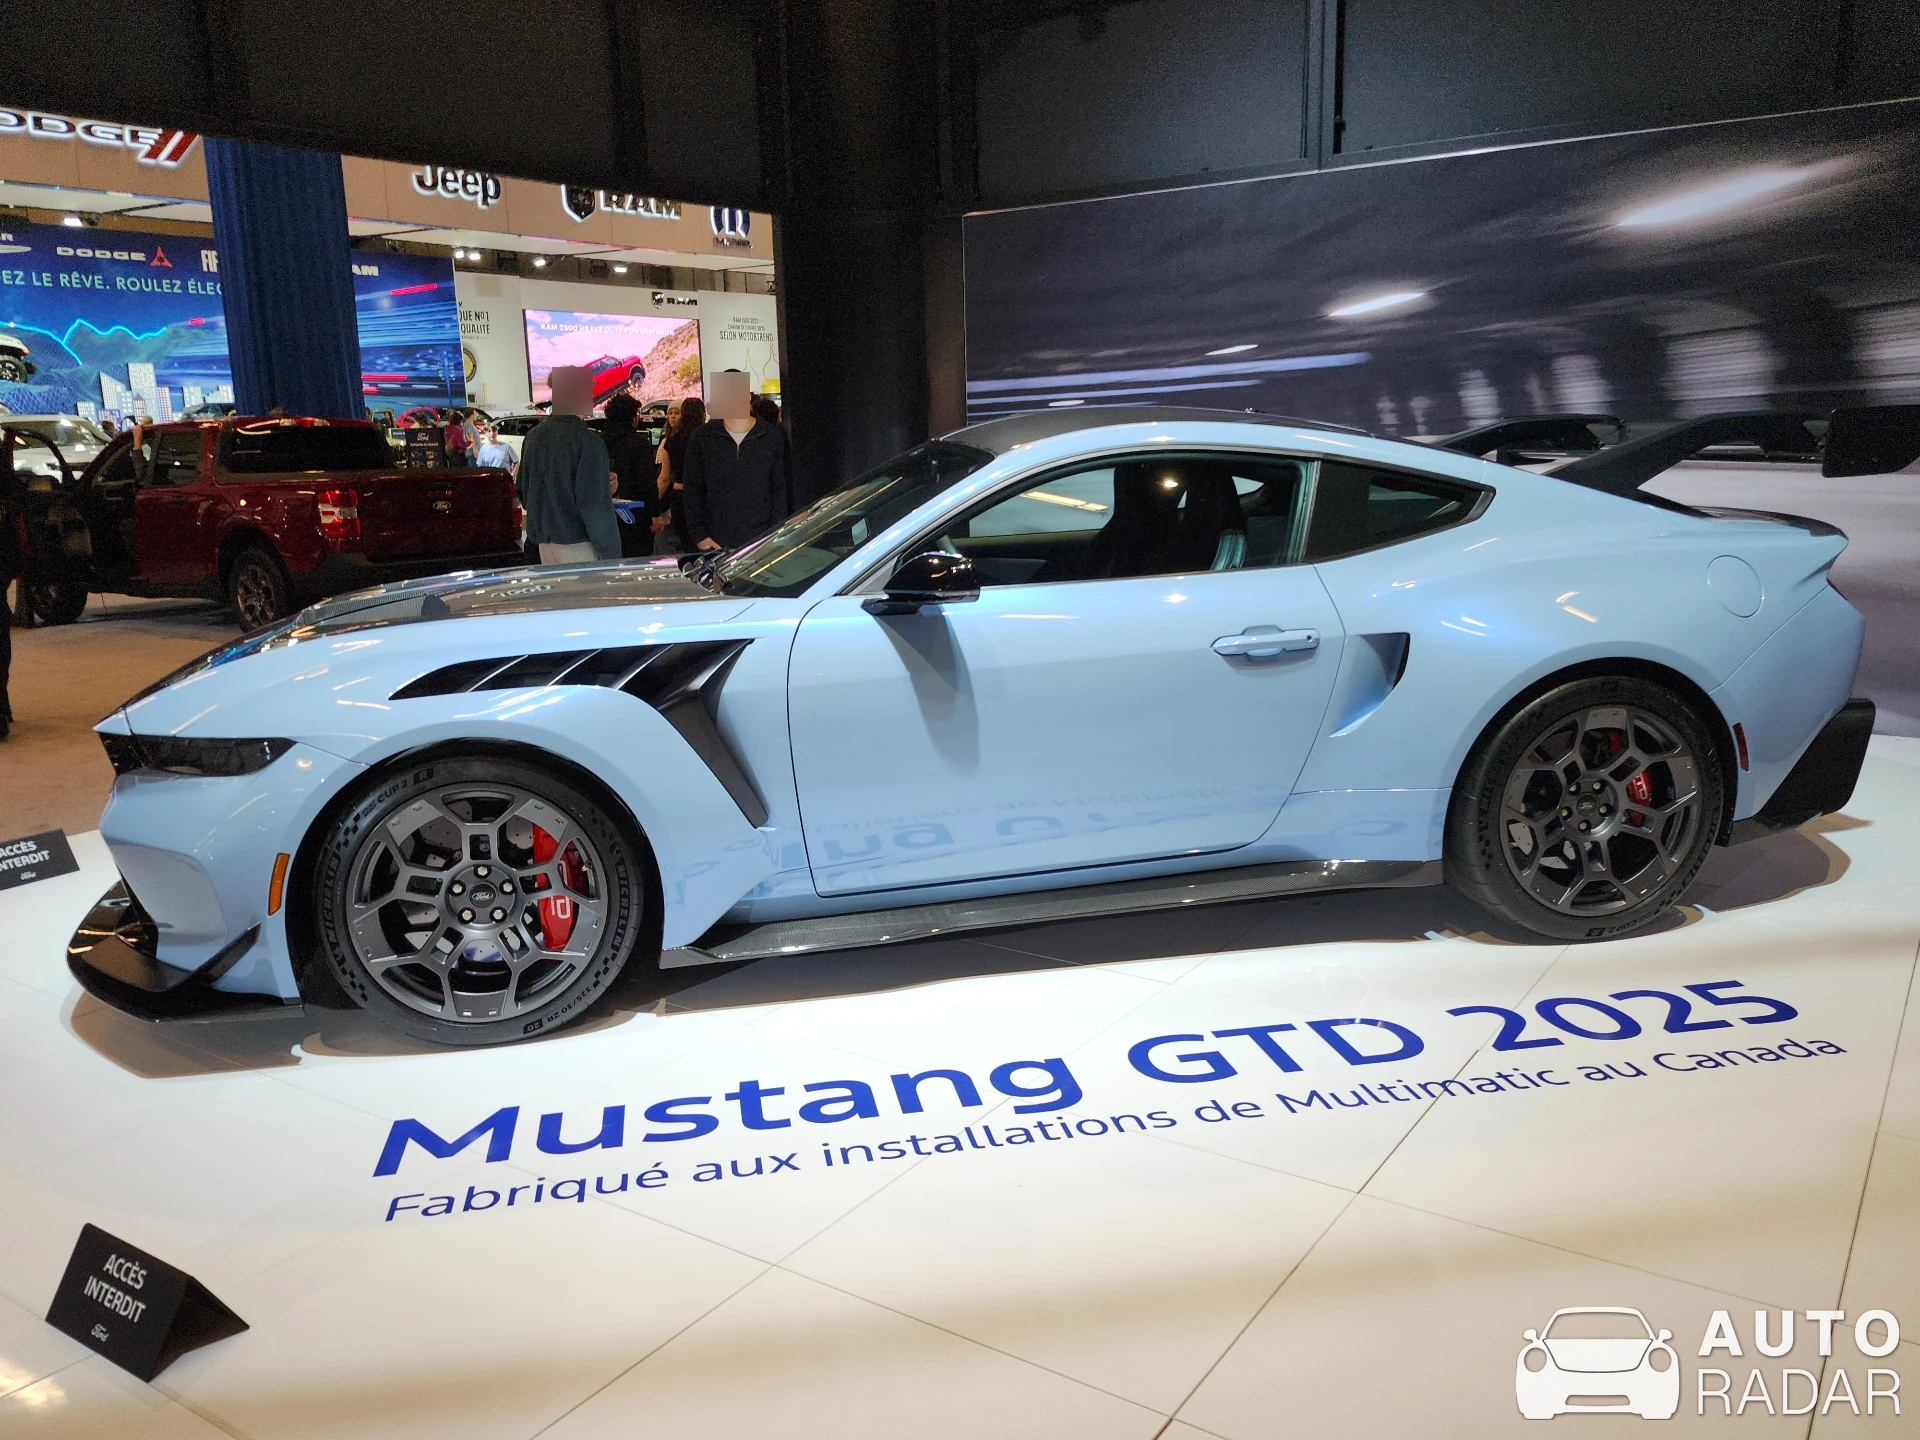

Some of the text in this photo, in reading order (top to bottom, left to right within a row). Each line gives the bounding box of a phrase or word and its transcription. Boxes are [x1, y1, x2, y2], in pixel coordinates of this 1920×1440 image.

[411, 164, 502, 211] Jeep
[56, 246, 147, 261] DODGE
[1, 269, 26, 286] EZ
[31, 271, 53, 288] LE
[59, 270, 111, 290] RÊVE.
[115, 276, 183, 294] ROULEZ
[666, 297, 698, 306] RAM
[460, 323, 490, 335] QUALITÉ
[540, 323, 558, 331] RAM
[559, 324, 579, 332] 2500
[579, 325, 603, 333] HEAVY
[719, 331, 737, 341] SELON
[377, 784, 400, 803] CUP
[373, 979, 1799, 1177] Mustang GTD 2025
[384, 1036, 1849, 1222] Fabriqué aux installations de Multimatic au Canada
[103, 1253, 147, 1290] ACCÈS
[83, 1275, 147, 1323] INTERDIT
